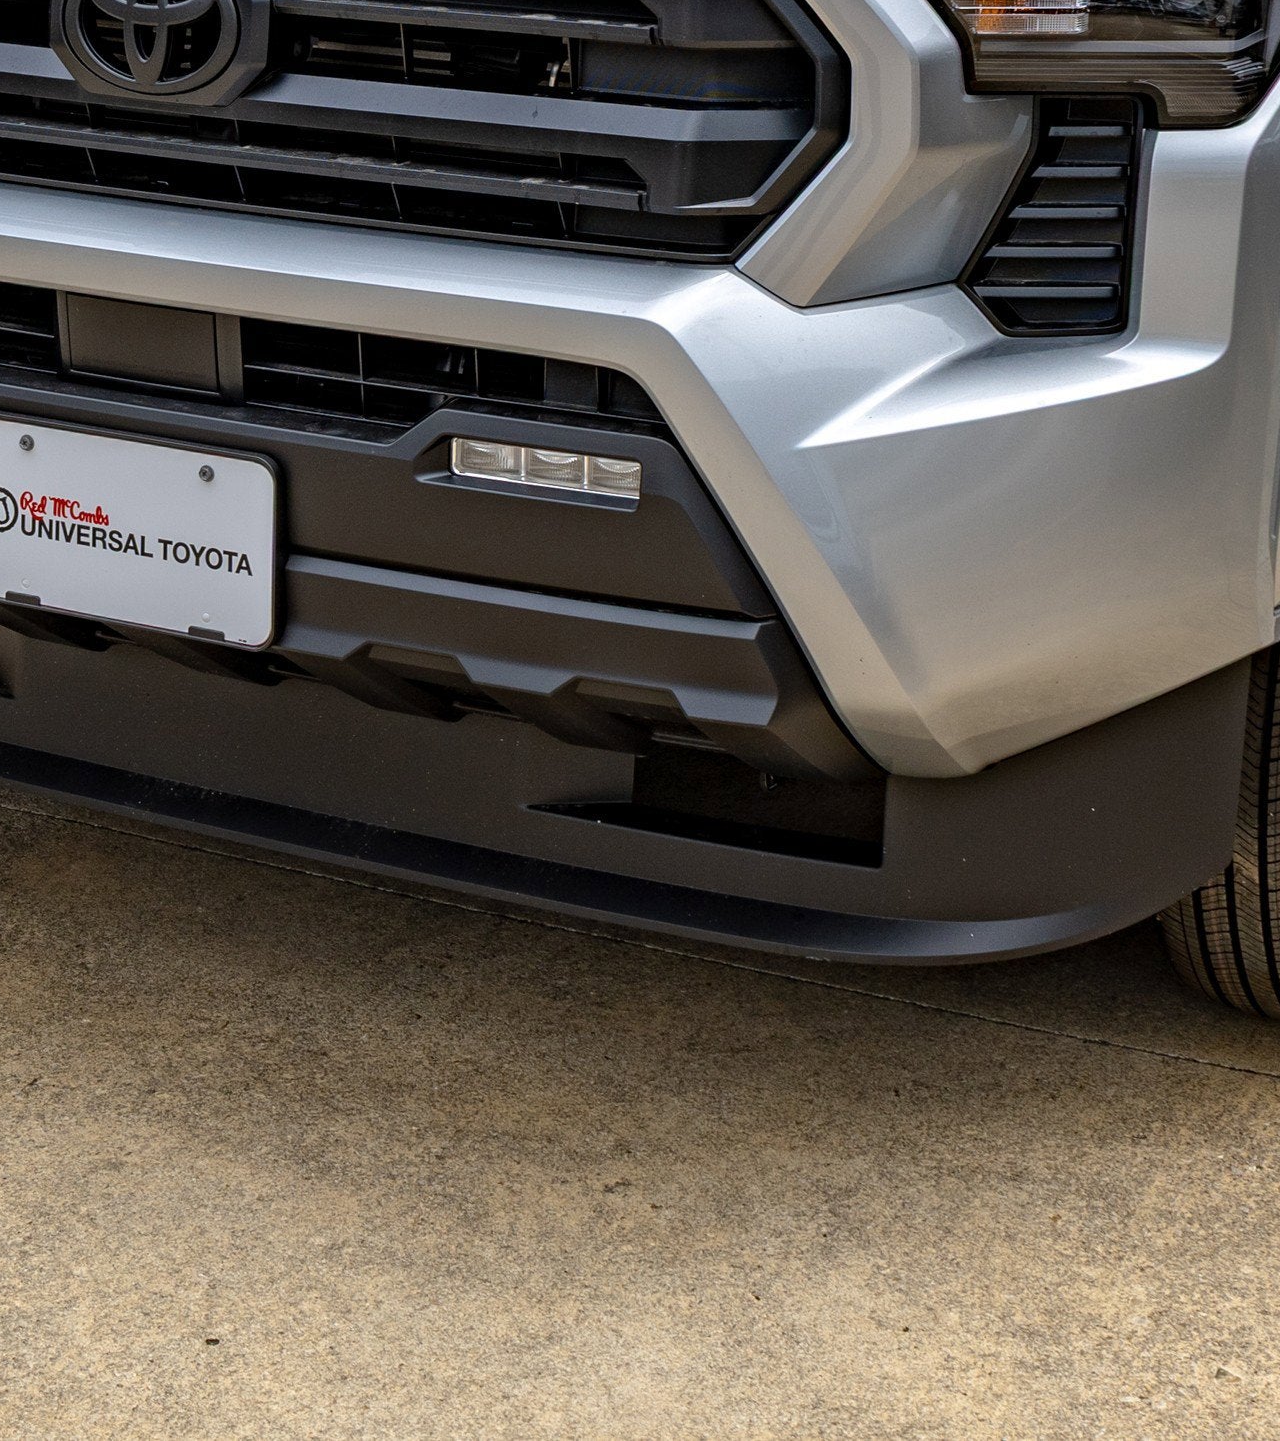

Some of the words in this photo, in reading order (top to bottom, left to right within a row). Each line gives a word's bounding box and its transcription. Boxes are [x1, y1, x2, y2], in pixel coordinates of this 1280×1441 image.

[20, 491, 47, 521] Red
[20, 514, 153, 558] UNIVERSAL
[158, 538, 253, 576] TOYOTA
